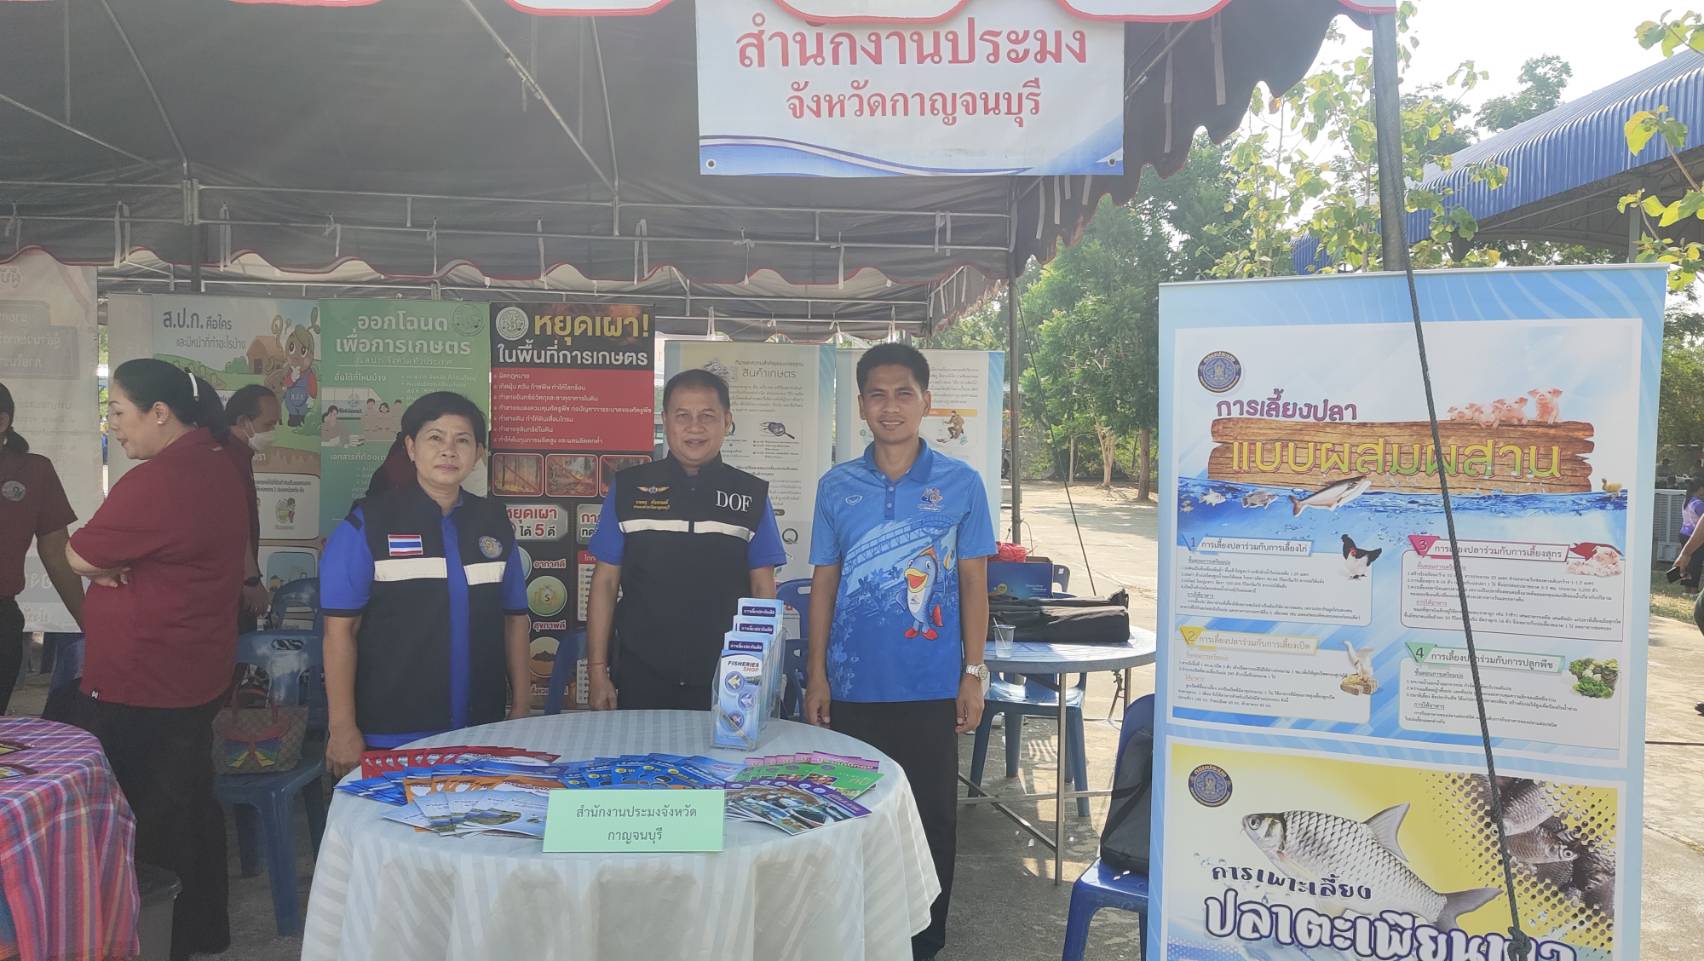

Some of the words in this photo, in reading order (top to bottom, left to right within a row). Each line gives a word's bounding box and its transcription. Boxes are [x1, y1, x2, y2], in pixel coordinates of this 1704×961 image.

[735, 12, 1088, 68] สำนกงานประมง
[786, 77, 1041, 128] จังหวัดกาญจนบุรี
[162, 307, 204, 329] ส.ป.ก.
[206, 313, 233, 330] คือใคร
[357, 310, 448, 331] ออกโฉนด
[533, 313, 649, 346] หยุดเผา!
[335, 326, 472, 355] เพื่อการเกษตร
[497, 337, 649, 366] ในพื้นที่การเกษตร
[1216, 388, 1358, 422] การเลี้ยงปลา
[1231, 437, 1563, 480] แบบผสมผสาน
[715, 490, 753, 513] DOF
[519, 525, 532, 537] ได้
[534, 523, 545, 537] 5
[547, 526, 556, 537] ดี
[1200, 537, 1308, 553] การเลี้ยงปลาร่วมกับการเลี้ยงไก่
[1418, 539, 1428, 550] 3
[1434, 543, 1562, 560] การเยงปลาร่วมกับการเลี้ยงสุกร
[1187, 630, 1198, 642] 2
[1415, 647, 1425, 658] 4
[1431, 650, 1554, 670] การเลี้ยงปาร่วมกับการปลูกพืช
[575, 804, 697, 818] สำนักงานประมงจังหวัด
[607, 826, 663, 845] กาญจนบุรี
[1211, 865, 1373, 901] การเพาะเลี้ยง
